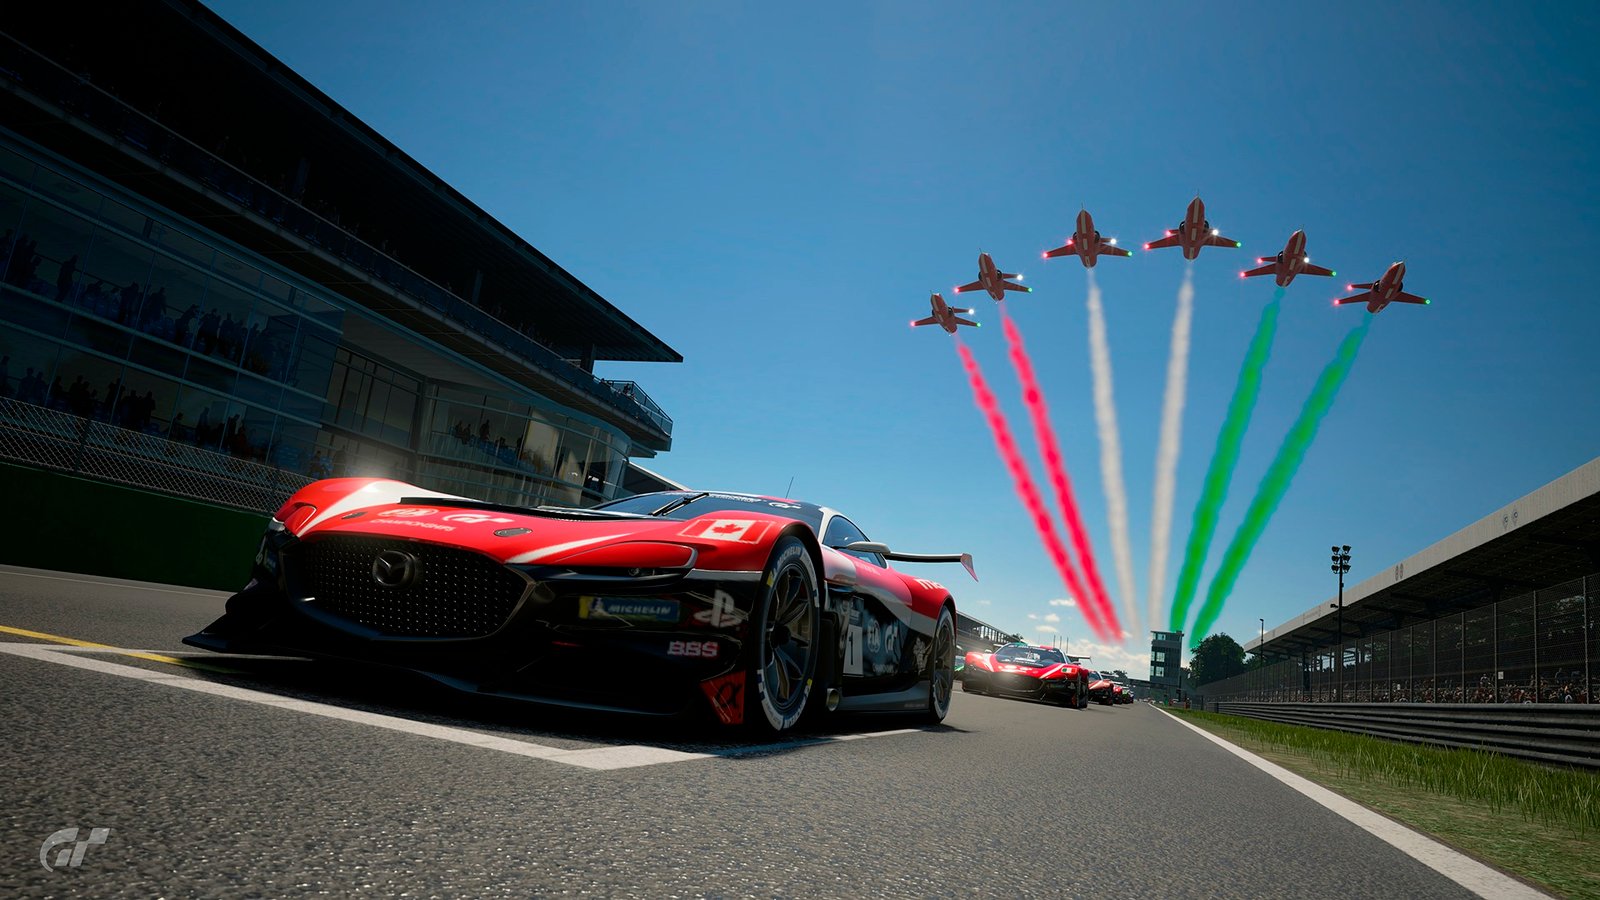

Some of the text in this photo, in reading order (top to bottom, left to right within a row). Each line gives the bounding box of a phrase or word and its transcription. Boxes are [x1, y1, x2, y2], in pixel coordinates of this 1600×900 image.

[607, 604, 671, 615] MICHELIN
[667, 641, 719, 658] BBS
[848, 631, 854, 666] 1
